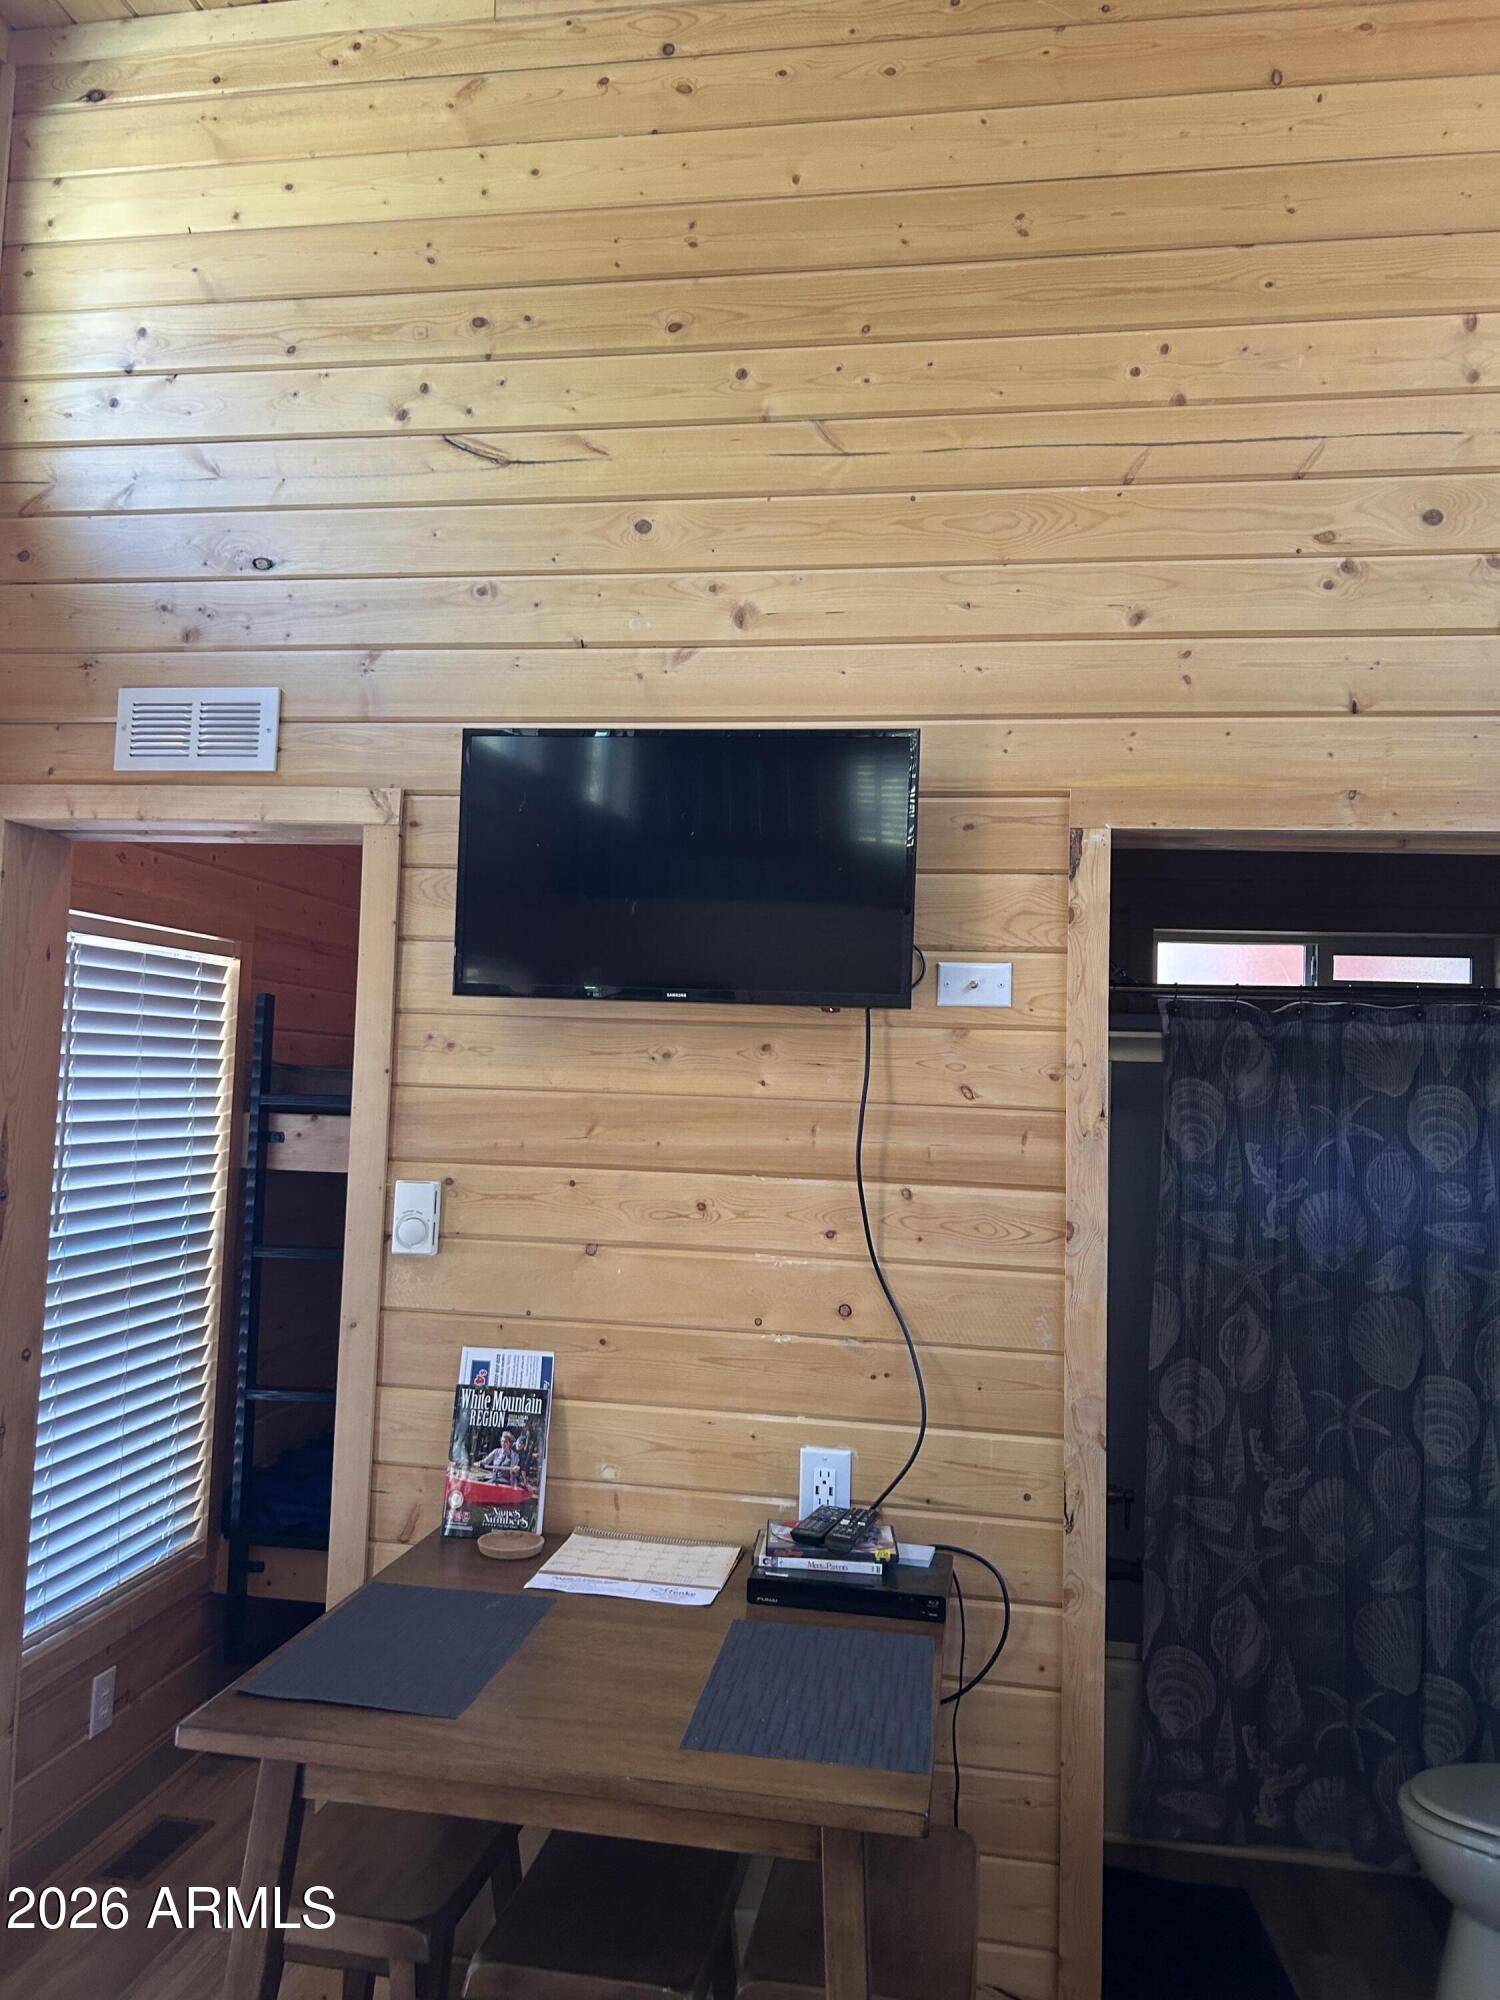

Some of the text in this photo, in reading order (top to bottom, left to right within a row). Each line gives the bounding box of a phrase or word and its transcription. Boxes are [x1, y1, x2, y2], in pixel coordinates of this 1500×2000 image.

[461, 1388, 543, 1415] White Mountain
[469, 1410, 506, 1428] REGION
[482, 1513, 529, 1528] Numbers
